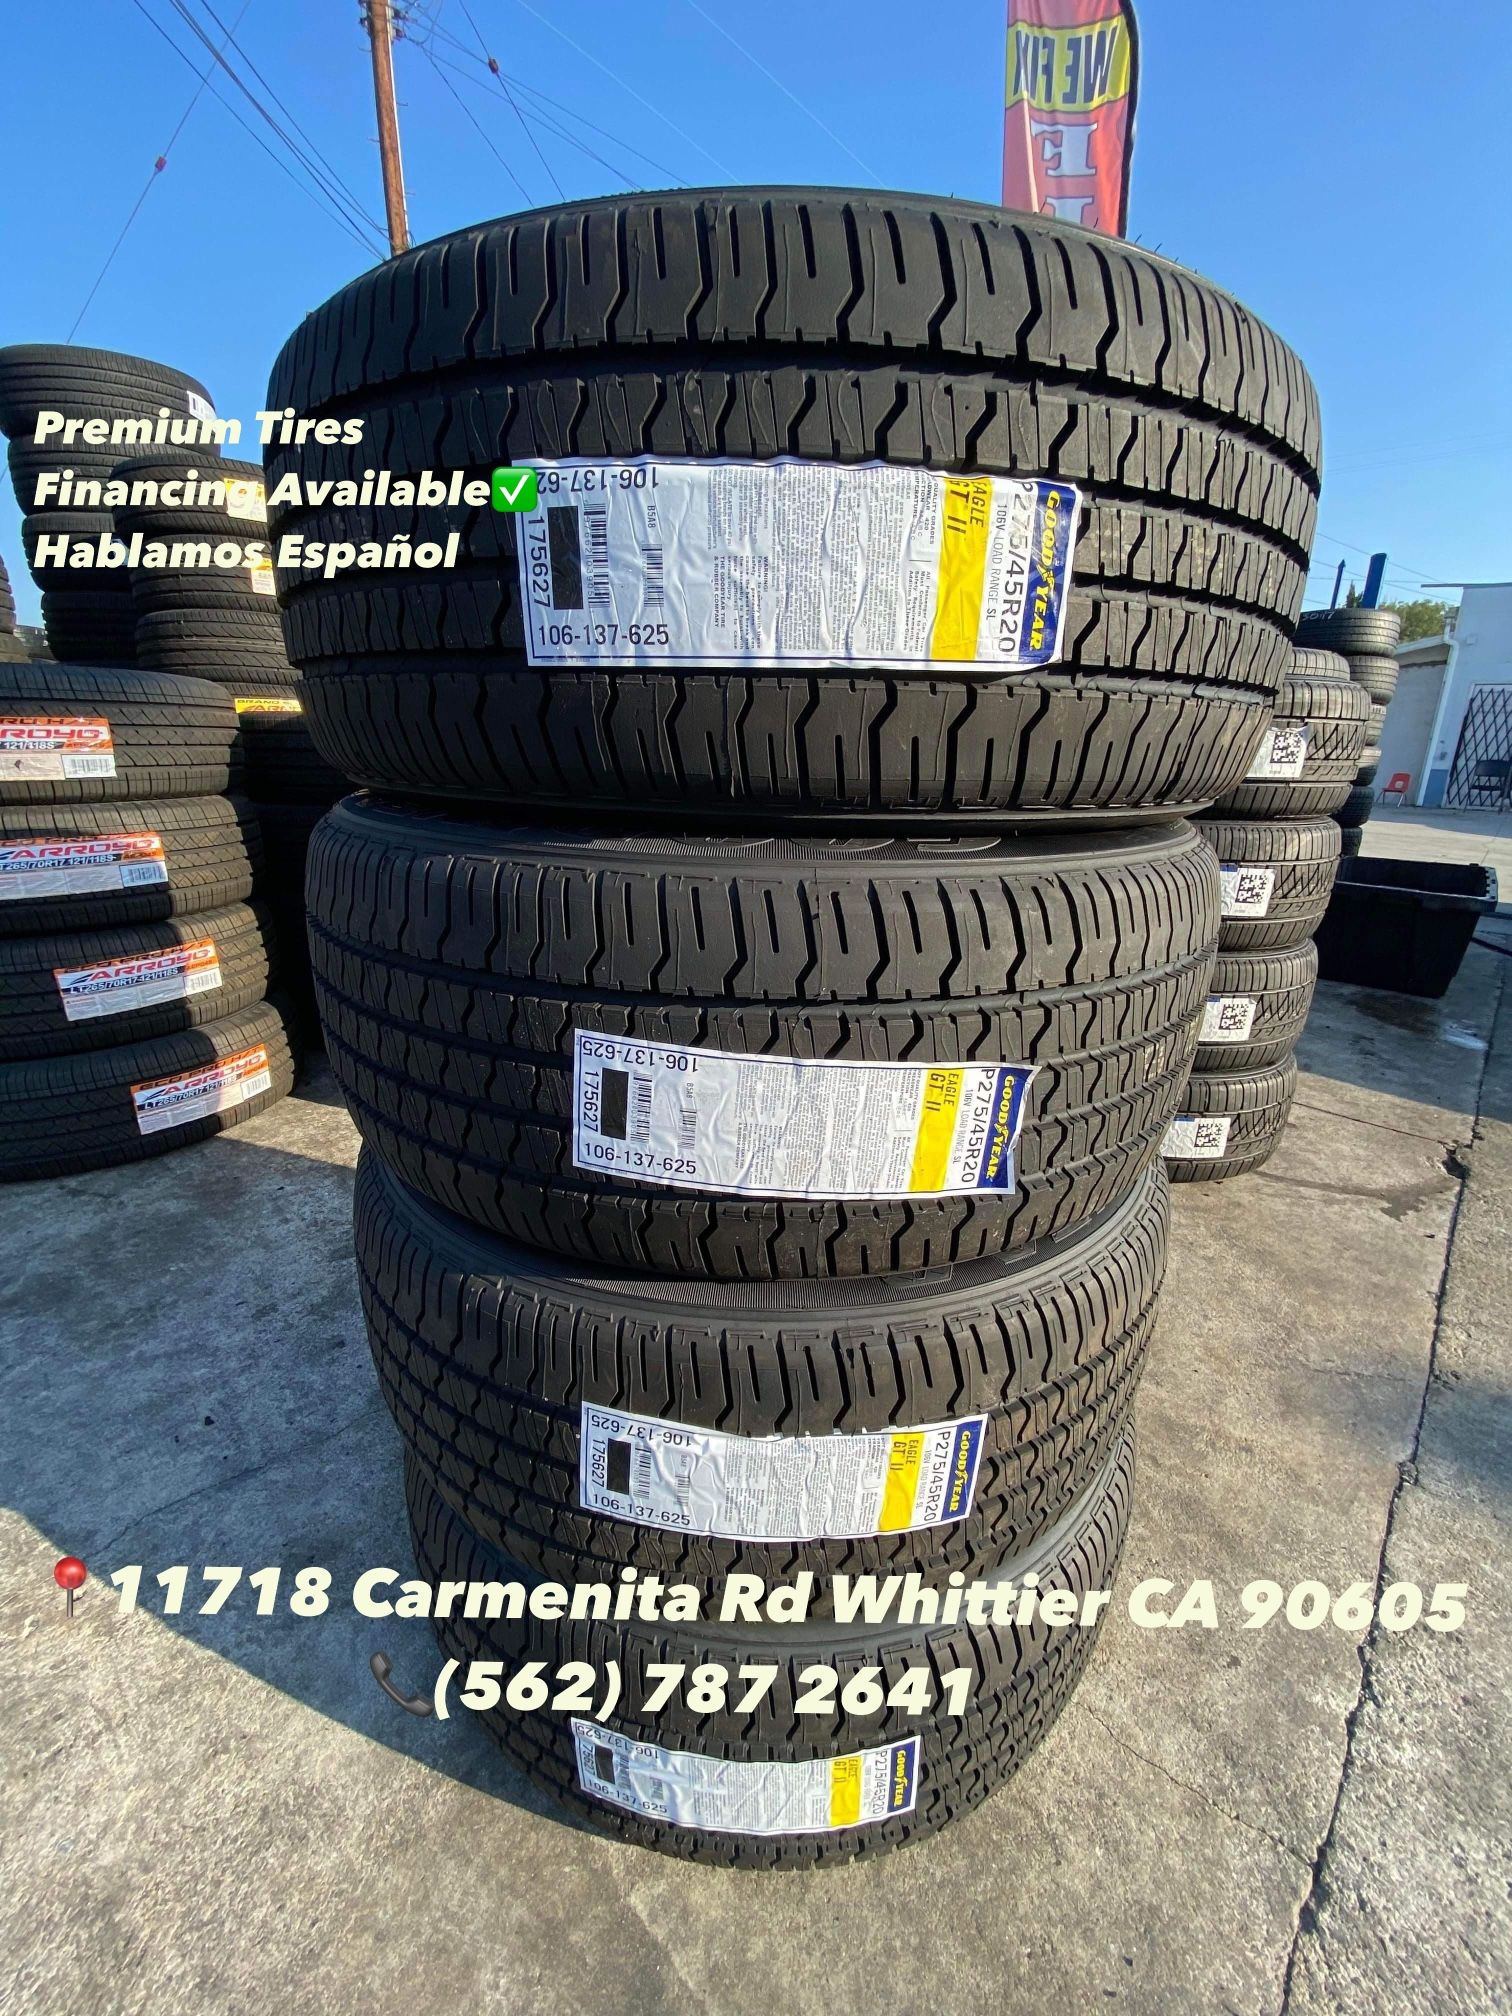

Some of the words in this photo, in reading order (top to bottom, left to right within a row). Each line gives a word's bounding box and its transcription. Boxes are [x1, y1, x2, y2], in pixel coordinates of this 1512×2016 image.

[537, 467, 659, 494] 106-137-62
[996, 504, 1008, 530] 106V
[528, 516, 550, 608] 175627
[992, 537, 1004, 564] LOAD
[988, 568, 1000, 602] RANGE
[1029, 490, 1061, 651] GOODYEAR
[986, 608, 995, 620] SL
[539, 624, 669, 646] 106-137-625
[583, 1041, 698, 1072] 106-137-625
[929, 1073, 945, 1092] GT
[944, 1073, 959, 1106] EAGLE
[584, 1071, 599, 1132] 175627
[961, 1069, 995, 1182] P275/45R20
[986, 1075, 1014, 1180] GOODYEAR
[585, 1143, 696, 1174] 106-137-625
[592, 1415, 691, 1447] 106-137-625
[592, 1439, 605, 1487] 175627
[893, 1441, 907, 1455] GT
[906, 1440, 919, 1465] EAGLE
[924, 1431, 950, 1522] P275/45R20
[950, 1431, 970, 1512] GOODYEAR
[594, 1494, 690, 1525] 106-137-625
[578, 1725, 658, 1759] 106-137-625
[894, 1750, 908, 1807] GOODYEAR
[589, 1779, 667, 1813] 106-137-625
